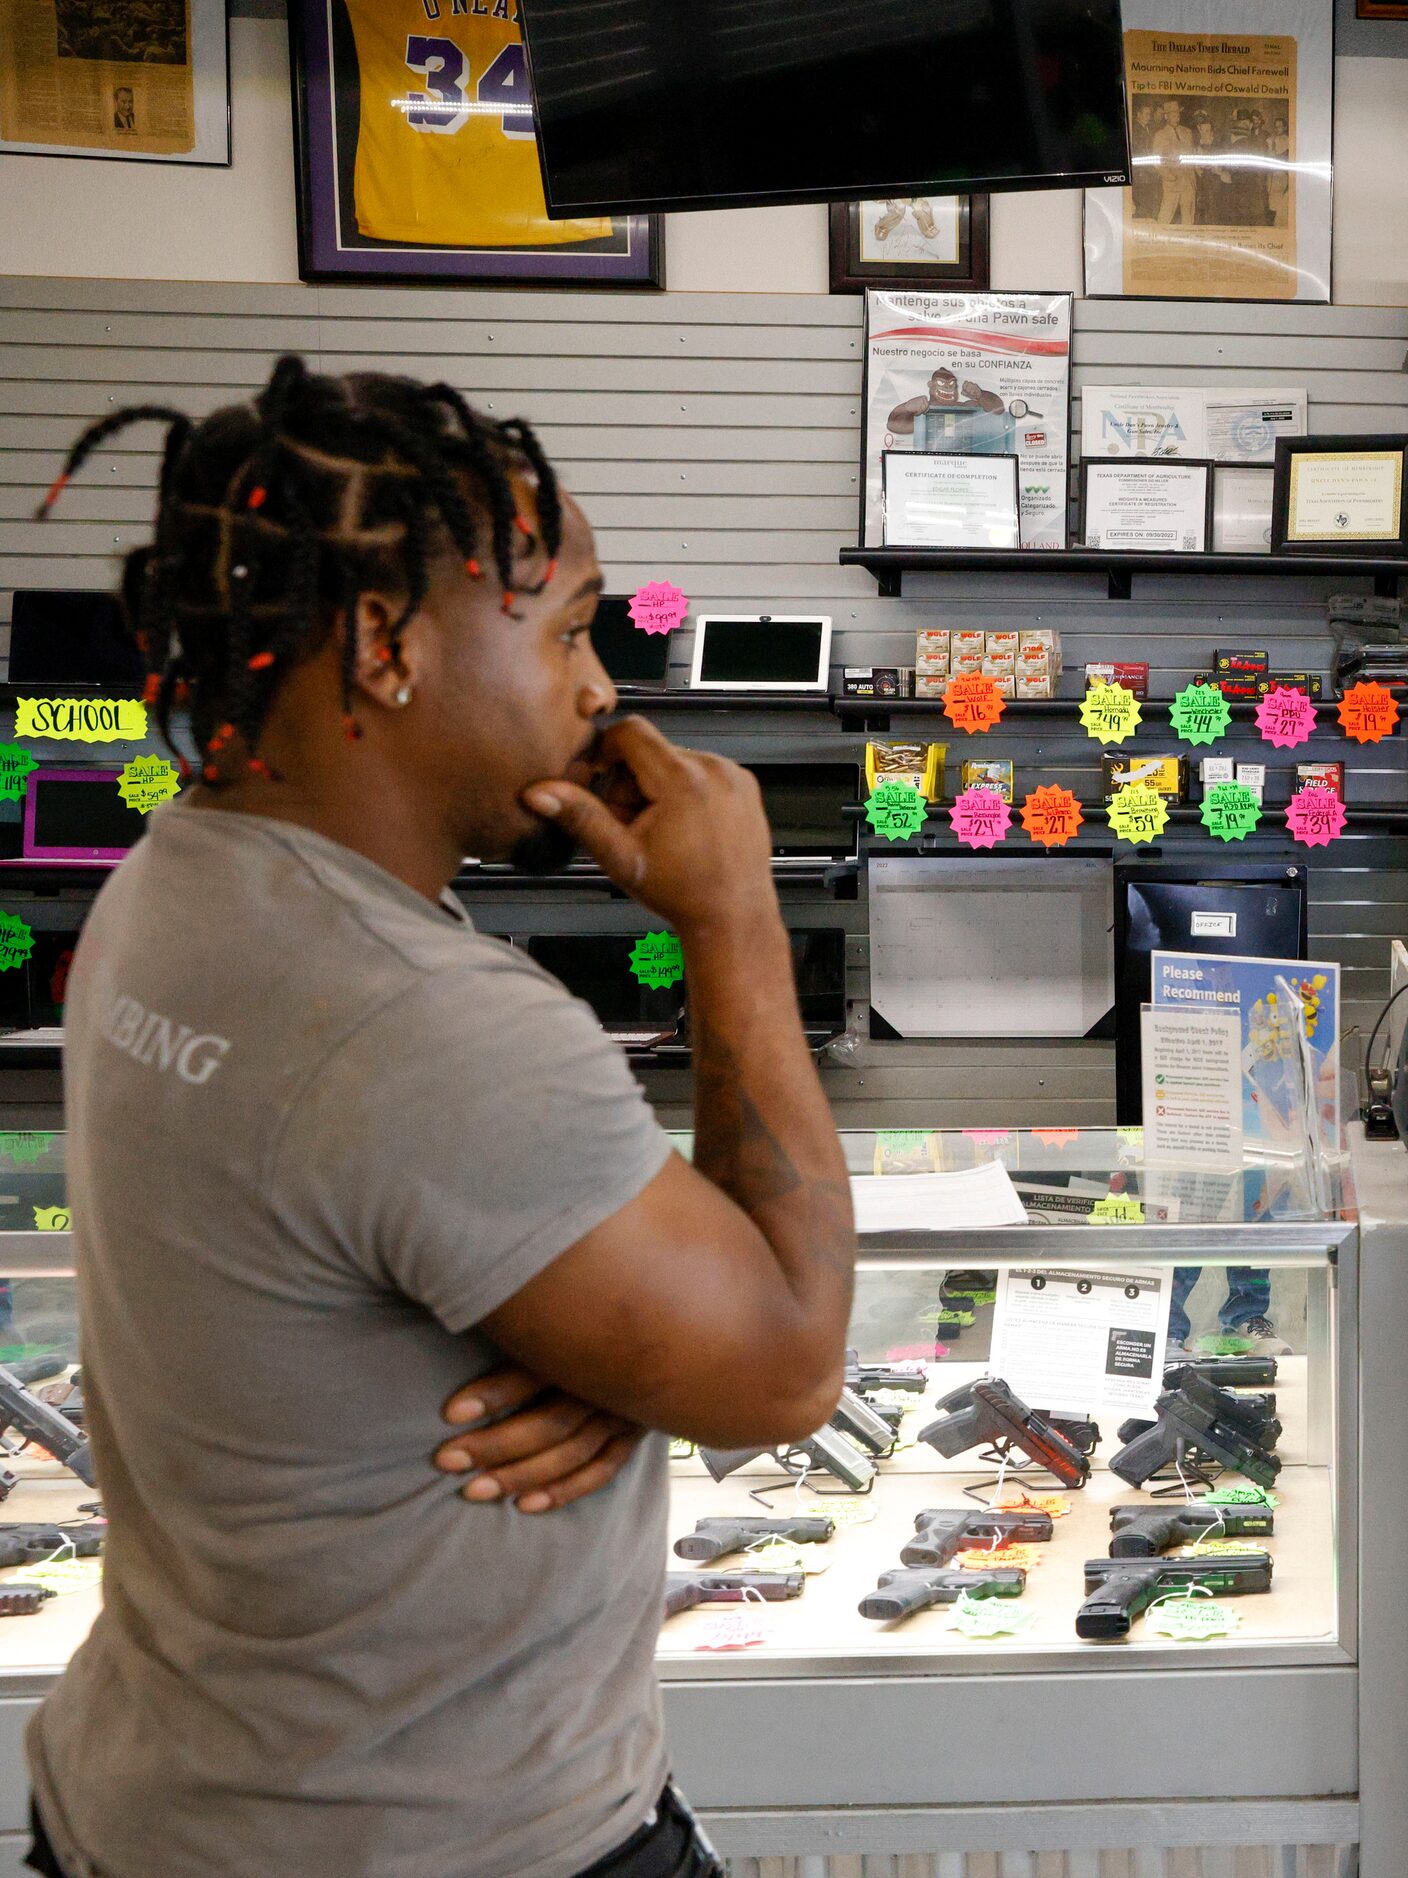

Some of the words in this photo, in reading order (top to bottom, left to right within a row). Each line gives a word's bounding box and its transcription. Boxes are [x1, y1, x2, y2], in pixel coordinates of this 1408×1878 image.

[1169, 42, 1196, 52] DALLAS
[1222, 43, 1250, 54] HERALD
[1131, 62, 1174, 74] Mourning
[1176, 64, 1206, 73] Nation
[1208, 65, 1226, 74] Bids
[1227, 65, 1250, 75] Chief
[1252, 66, 1289, 77] Farewell
[405, 34, 536, 140] 34
[1132, 81, 1146, 90] Tip
[1159, 81, 1172, 90] FBI
[1175, 82, 1213, 92] Warned
[1214, 83, 1224, 92] of
[1225, 84, 1260, 93] Oswald
[1261, 85, 1289, 94] Death
[942, 297, 965, 307] sus
[993, 312, 1028, 324] Pawn
[1032, 313, 1059, 325] safe
[873, 348, 908, 356] Nuestro
[911, 348, 945, 358] negocio
[960, 349, 981, 357] basa
[979, 360, 1032, 369] CONFIANZA
[1101, 410, 1187, 450] NPA
[641, 592, 679, 601] SALE
[954, 683, 994, 696] SALE
[1091, 694, 1131, 706] SALE
[1180, 696, 1220, 708] SALE
[1268, 699, 1308, 713] SALE
[1350, 694, 1388, 706] SALE
[1104, 705, 1130, 718] Hornady
[1362, 705, 1389, 713] Holster
[31, 701, 134, 733] SCHOOL
[129, 766, 168, 777] SALE
[1305, 779, 1328, 787] FIELD
[876, 792, 916, 804] SALE
[1032, 797, 1071, 810] SALE
[1118, 795, 1157, 808] SALE
[1210, 792, 1250, 805] SALE
[1297, 798, 1336, 809] SALE
[960, 800, 1000, 811] SALE
[640, 944, 679, 953] SALE
[654, 952, 664, 960] HP
[1163, 965, 1204, 981] Please
[1163, 985, 1241, 1003] Recommend
[1155, 1025, 1189, 1034] Background
[1211, 1027, 1229, 1037] Policy
[1161, 1037, 1186, 1045] Effective
[1187, 1038, 1201, 1046] April
[1034, 1194, 1054, 1202] LISTA
[1022, 1201, 1091, 1213] ALMACENAMIENTO
[1036, 1279, 1041, 1287] 1
[1049, 1270, 1102, 1280] ALMACENAMIENTO
[1135, 1278, 1155, 1286] ARMAS
[1081, 1284, 1088, 1292] 2
[1128, 1288, 1135, 1296] 3
